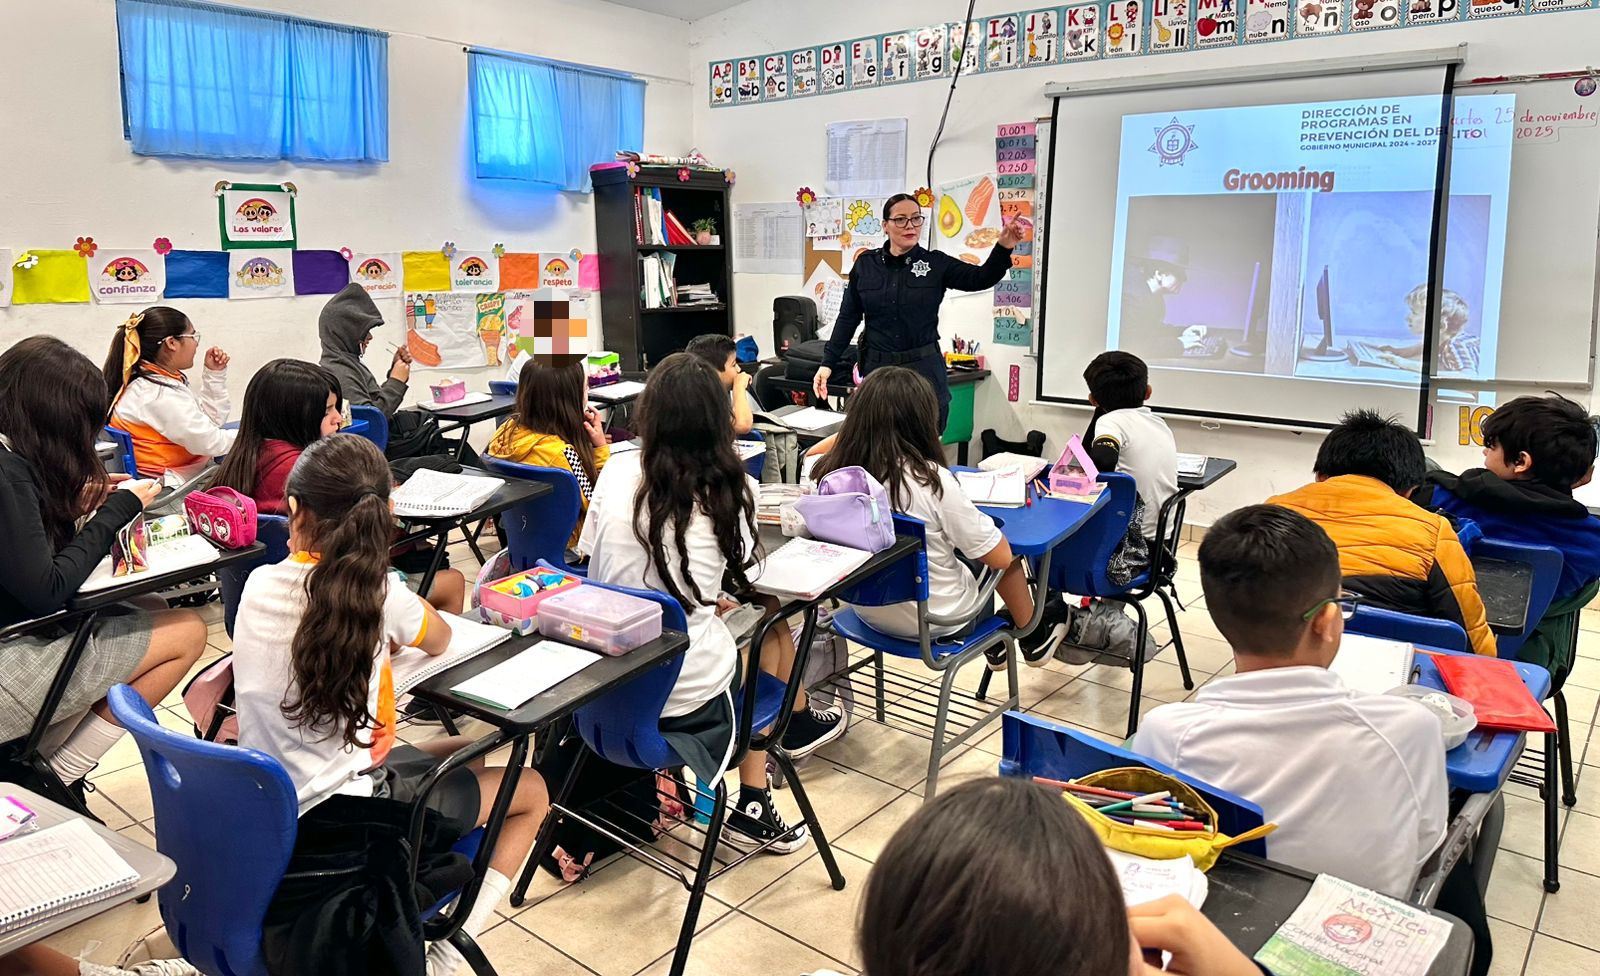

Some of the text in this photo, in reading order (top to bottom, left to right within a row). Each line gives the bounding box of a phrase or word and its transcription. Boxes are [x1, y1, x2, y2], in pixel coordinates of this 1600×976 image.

[1264, 1, 1287, 9] Nemo
[1474, 5, 1503, 14] queso
[1068, 9, 1079, 27] K
[1110, 4, 1118, 21] L
[1324, 6, 1338, 27] ñ
[1380, 6, 1397, 21] o
[1412, 12, 1436, 21] perro
[989, 20, 999, 38] I
[1027, 15, 1035, 32] J
[1216, 20, 1235, 34] m
[1272, 18, 1285, 34] n
[884, 38, 892, 53] F
[917, 33, 930, 48] G
[1084, 35, 1095, 53] k
[1200, 35, 1233, 44] manzana
[822, 49, 832, 64] D
[853, 43, 861, 59] E
[1007, 46, 1011, 64] i
[1045, 40, 1051, 61] j
[765, 58, 774, 72] C
[793, 53, 806, 65] Ch
[932, 56, 942, 73] g
[713, 65, 722, 79] A
[740, 62, 746, 76] B
[867, 65, 876, 77] e
[899, 61, 904, 76] f
[806, 78, 816, 87] ch
[835, 70, 844, 85] d
[724, 87, 732, 98] a
[752, 82, 759, 96] b
[778, 82, 785, 92] c
[1302, 104, 1400, 119] DIRECCIÓN DE
[1520, 109, 1534, 123] de
[1537, 105, 1597, 122] noviembre
[1301, 115, 1412, 130] PROGRAMAS EN
[999, 126, 1026, 136] 0.009
[1300, 128, 1389, 142] PREVENCIÓN
[1393, 128, 1420, 138] DEL
[1517, 126, 1554, 139] 2025
[998, 139, 1027, 149] 0.078
[999, 150, 1026, 161] 0.205
[999, 163, 1028, 173] 0.250
[998, 176, 1025, 186] 0.502
[1223, 166, 1335, 192] Grooming
[234, 225, 249, 233] Los
[99, 284, 156, 294] confianza
[543, 278, 572, 287] respeto
[996, 333, 1020, 341] 6.18
